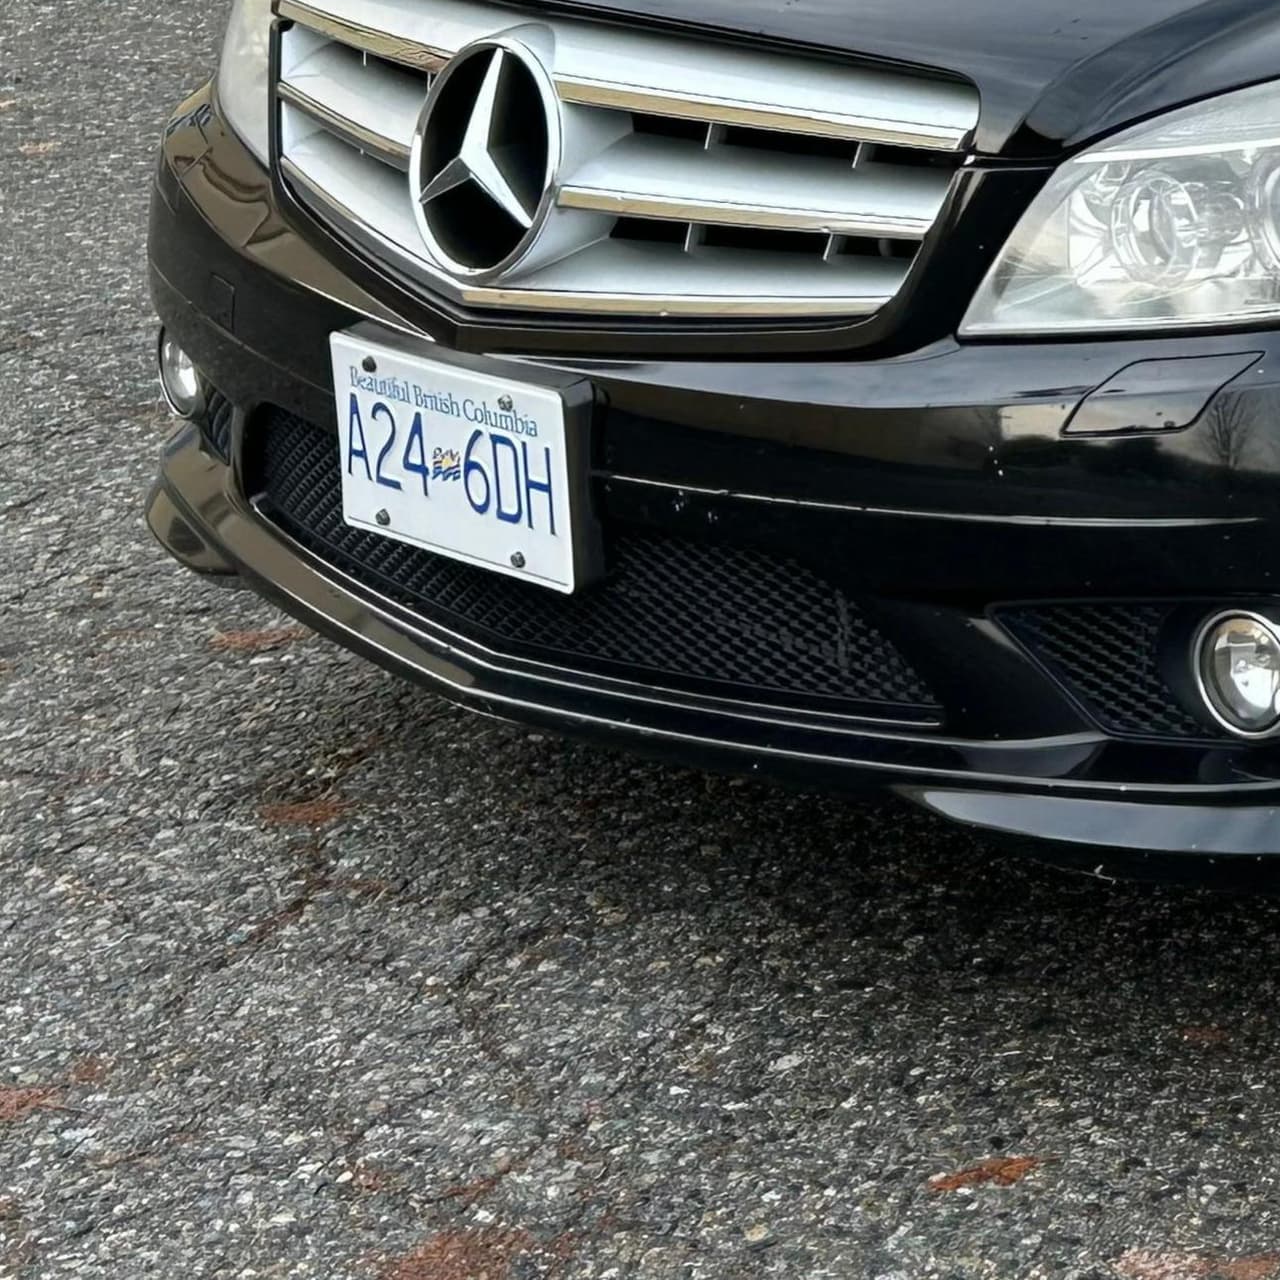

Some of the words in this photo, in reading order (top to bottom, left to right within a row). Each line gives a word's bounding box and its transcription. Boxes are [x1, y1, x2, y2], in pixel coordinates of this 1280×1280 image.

[350, 366, 410, 403] Beautiful
[413, 384, 460, 418] British
[462, 398, 538, 438] Columbia
[348, 392, 429, 498] A24
[463, 428, 557, 537] 6DH
